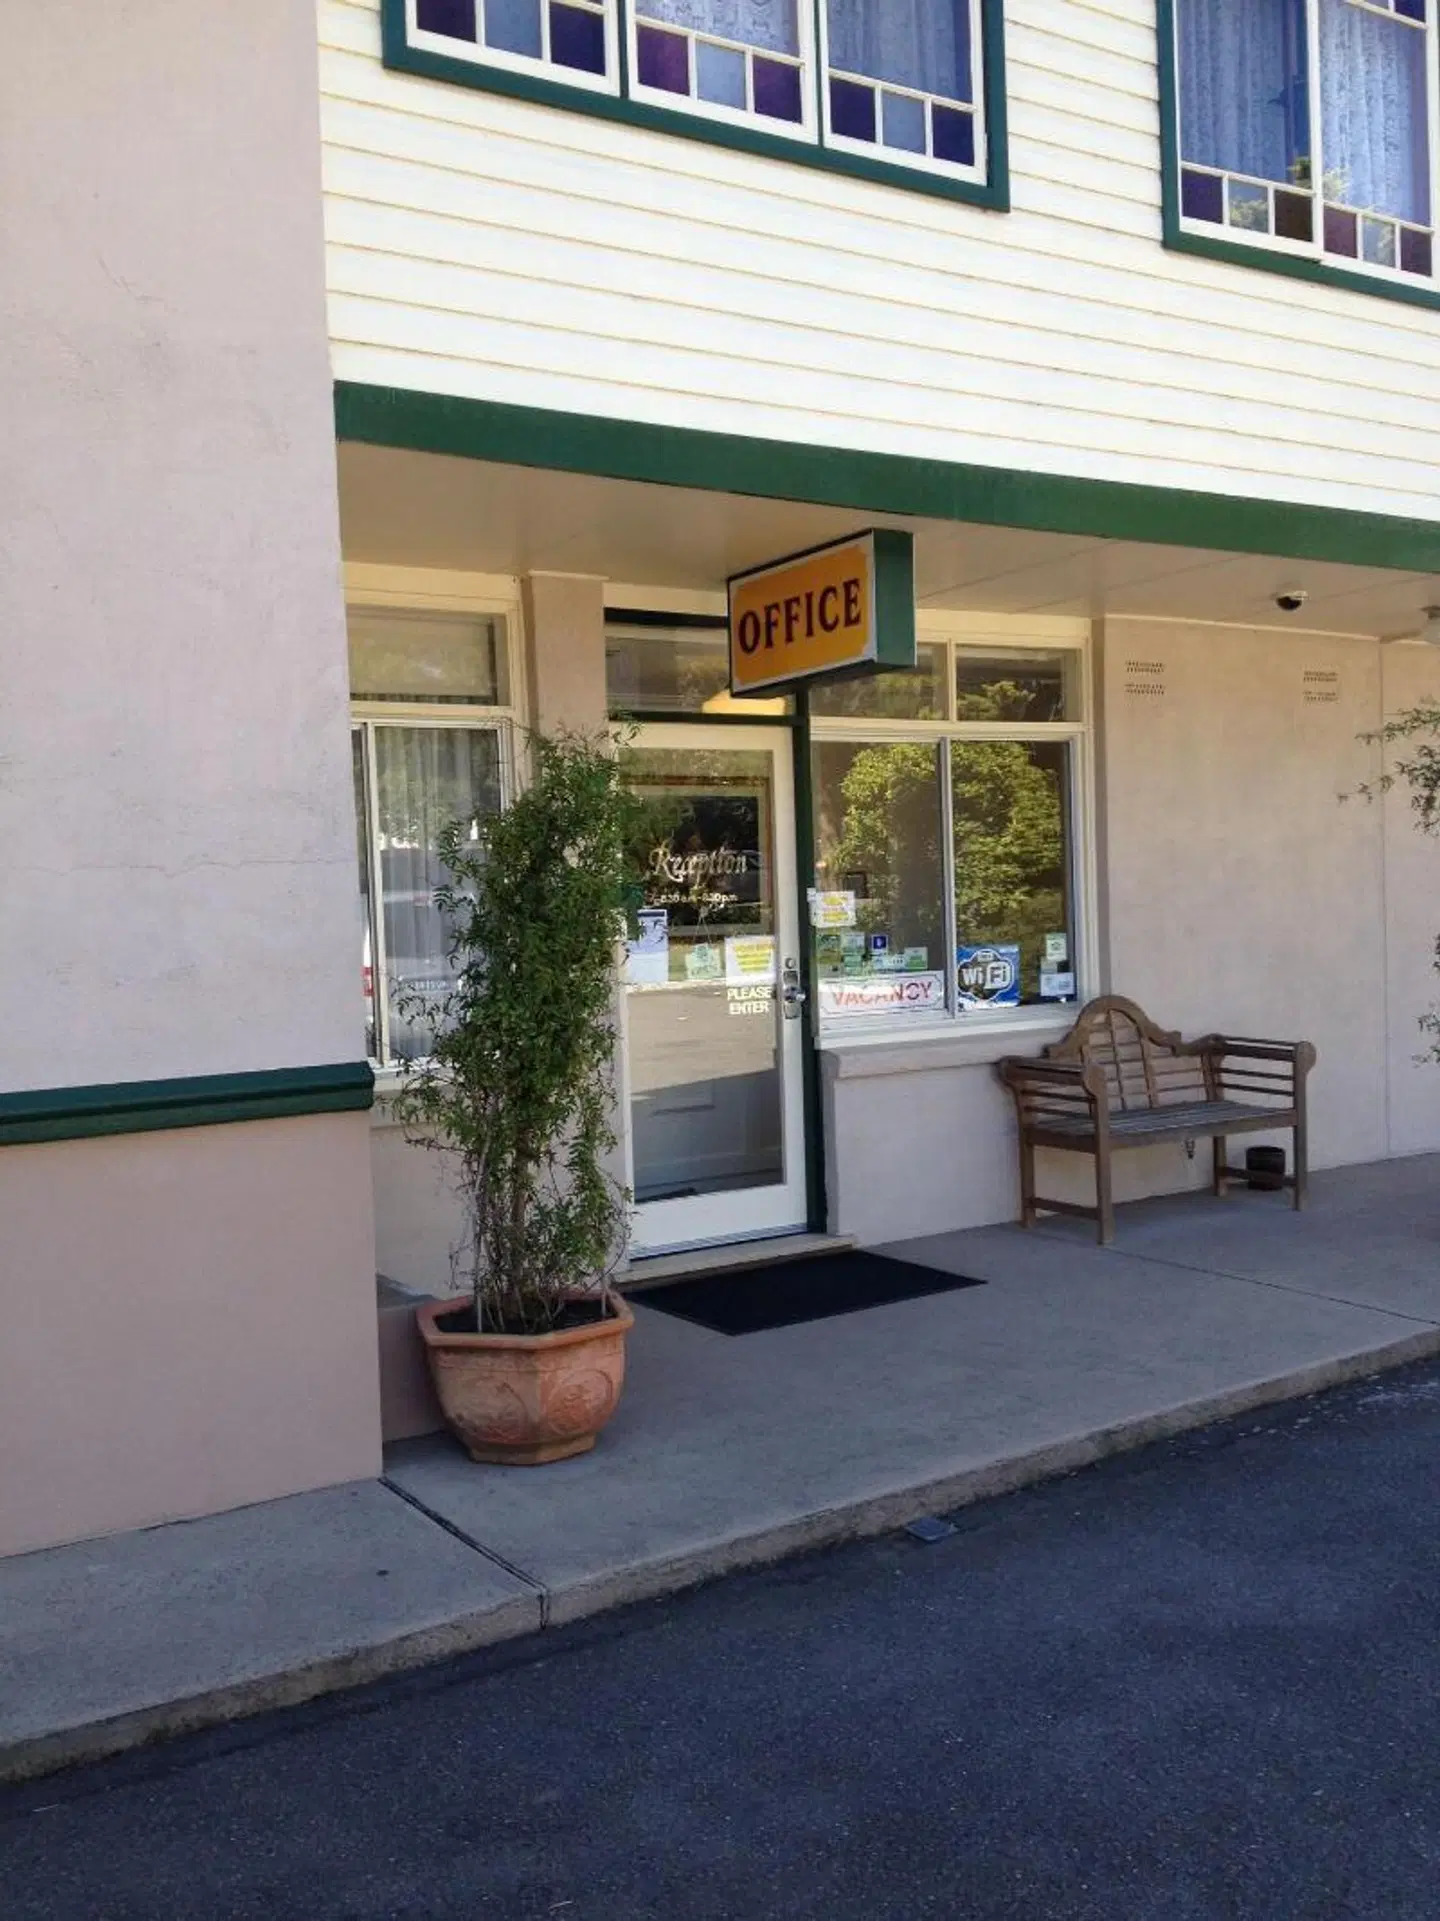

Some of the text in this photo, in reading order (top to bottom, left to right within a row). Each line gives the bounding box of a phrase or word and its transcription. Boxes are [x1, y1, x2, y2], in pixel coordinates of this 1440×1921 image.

[738, 578, 861, 654] OFFICE
[648, 847, 748, 887] Reception
[727, 986, 772, 1001] PLEASE
[834, 981, 932, 1005] VACANCY
[729, 1001, 769, 1015] ENTER
